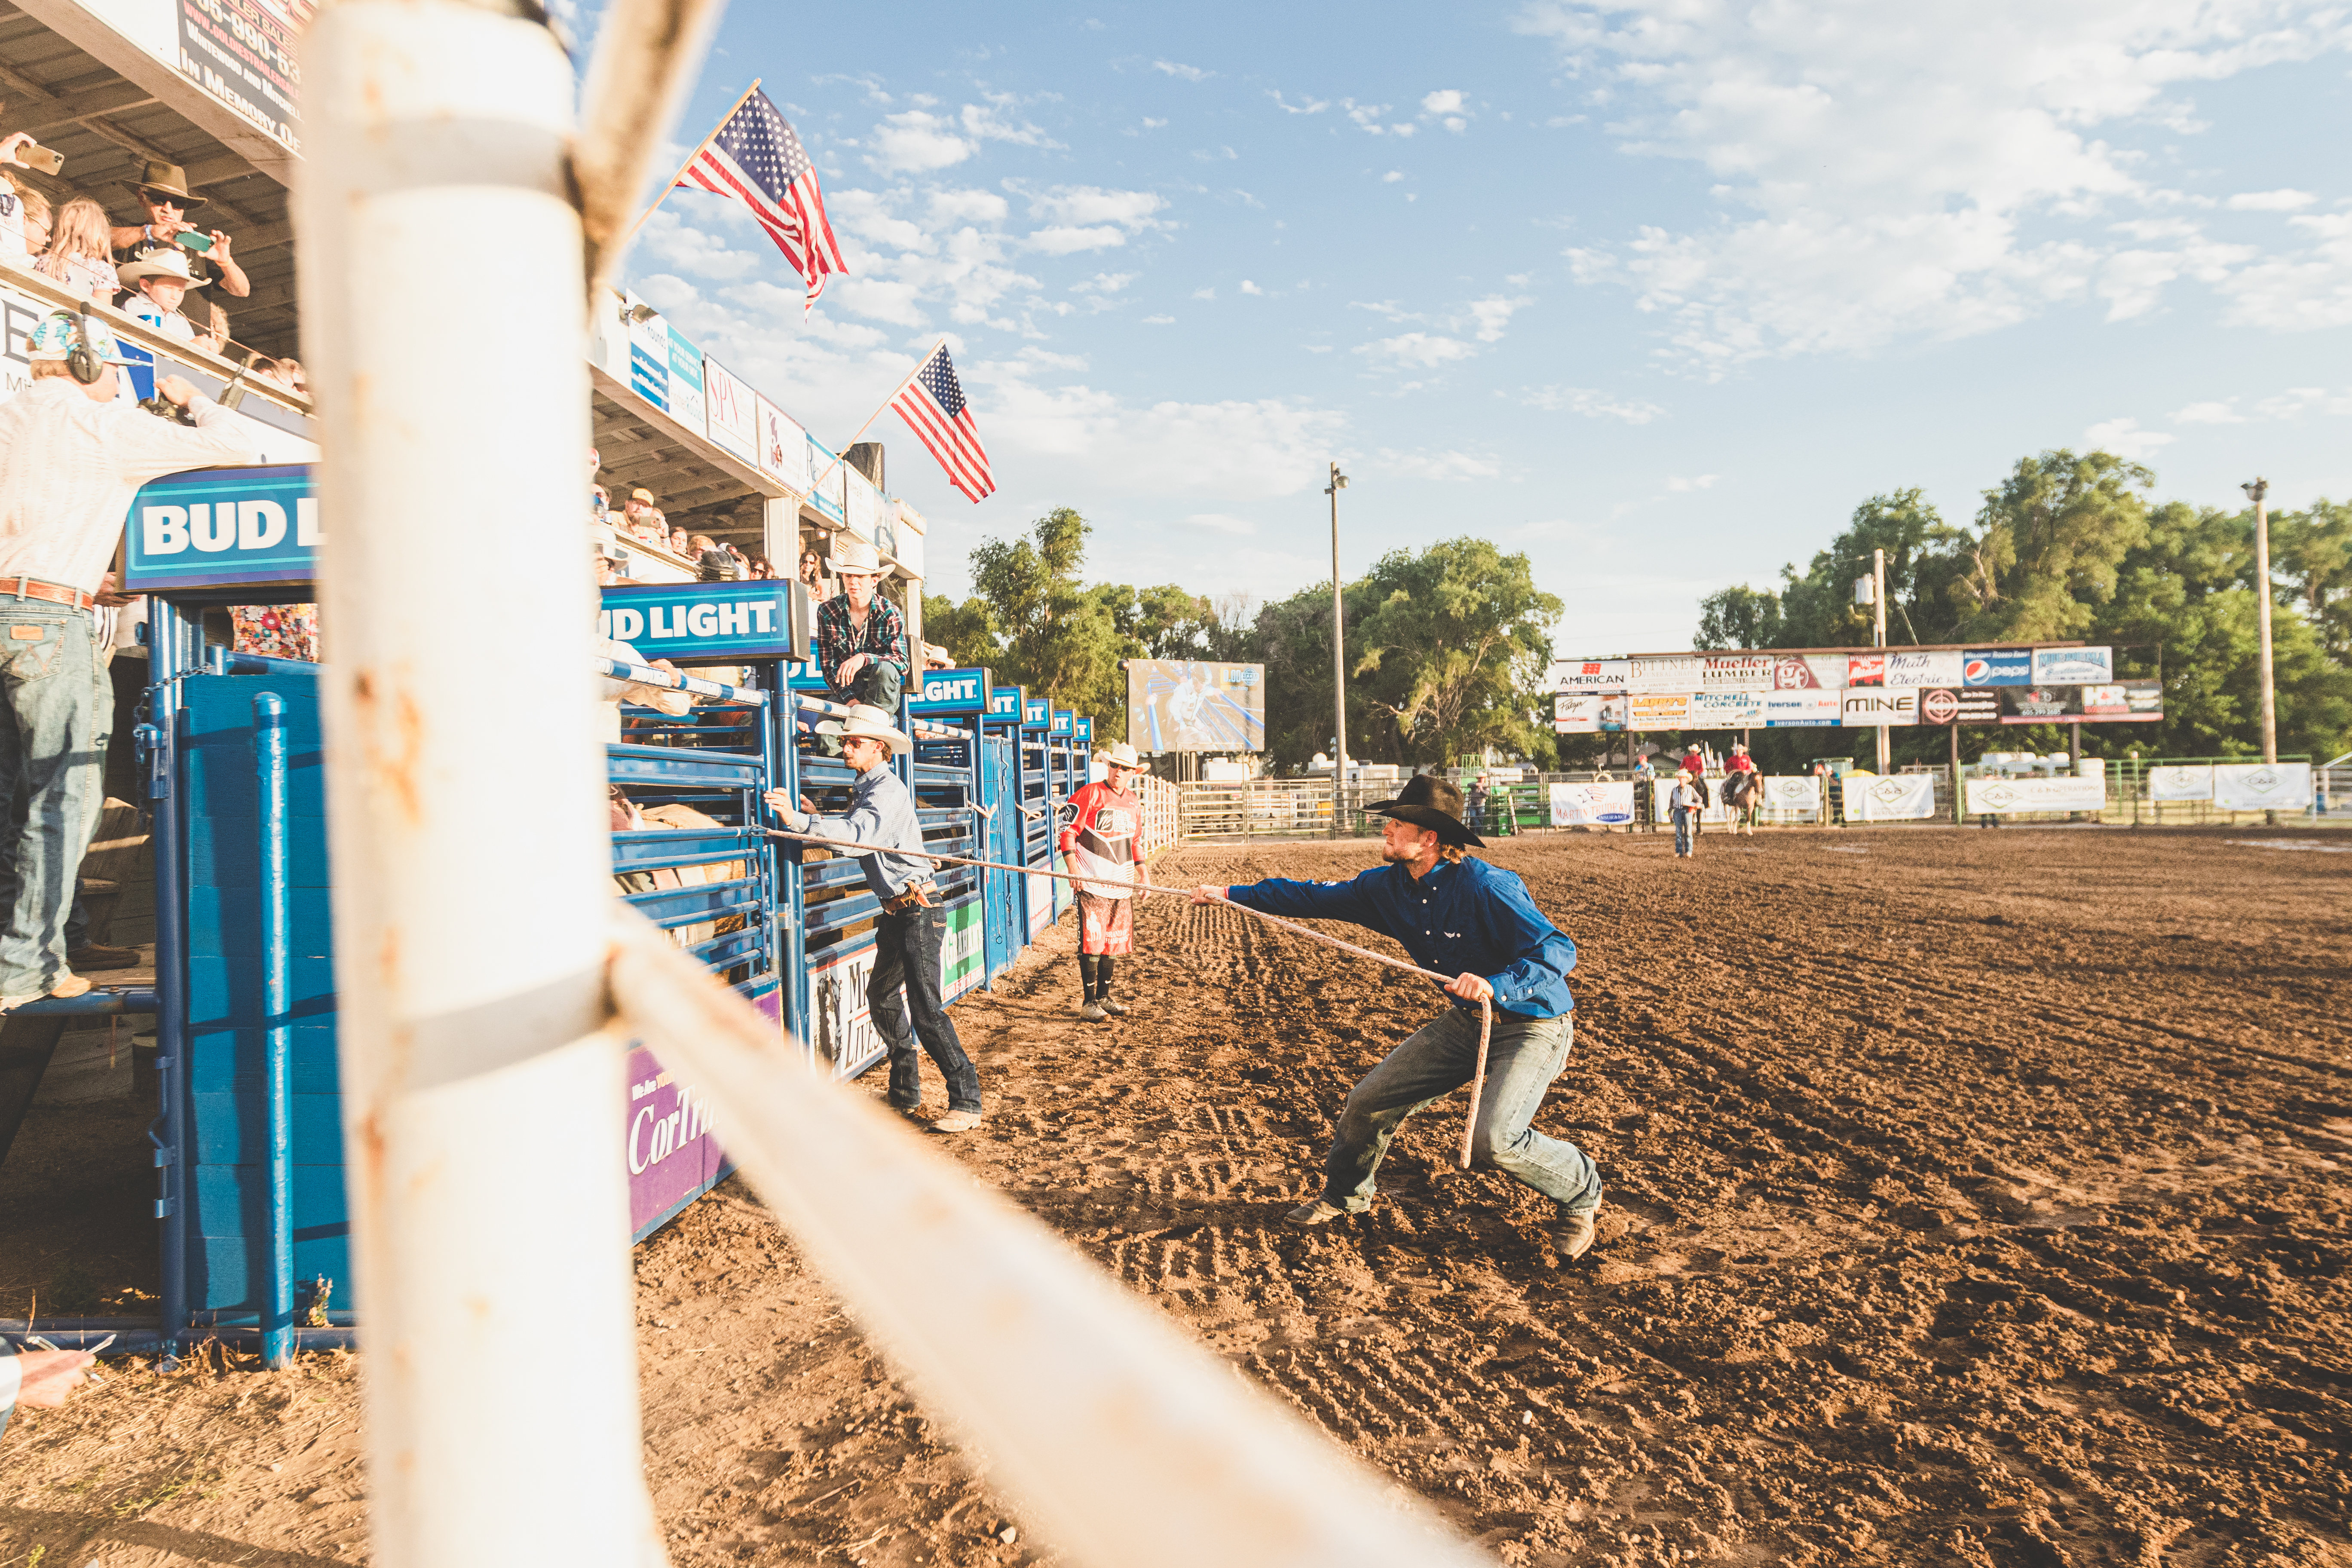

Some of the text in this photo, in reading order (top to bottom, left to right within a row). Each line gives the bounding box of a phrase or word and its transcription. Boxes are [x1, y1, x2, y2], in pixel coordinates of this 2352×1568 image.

[262, 17, 299, 56] SALES
[186, 18, 242, 76] WHITEWOOD
[243, 68, 261, 90] AND
[181, 46, 200, 81] IN
[204, 65, 276, 134] MEMORY
[710, 365, 739, 430] SPN
[142, 499, 288, 555] BUD
[649, 600, 776, 639] LIGHT
[1630, 658, 1698, 678] BITTNER
[1705, 657, 1771, 669] Mueller
[1890, 654, 1931, 669] Muth
[1224, 669, 1241, 683] 0.00
[1703, 669, 1772, 678] LUMBER
[1850, 665, 1883, 679] Mitchell
[1992, 665, 2029, 677] pepsi
[1560, 675, 1625, 685] AMERICAN
[1890, 673, 1944, 686] Electric
[1558, 698, 1588, 714] Patzer
[1632, 696, 1687, 707] LARRY'S
[1703, 700, 1762, 708] CONCRETE
[1846, 695, 1914, 712] MINE
[1874, 787, 1902, 796] C&B
[1984, 791, 2014, 801] C&B
[1556, 802, 1630, 820] MARTIN-TRUDEAU
[946, 919, 983, 970] GRAHAM'S
[1105, 936, 1128, 945] HAMPIONS
[955, 974, 971, 993] SOUTH
[970, 966, 984, 984] BURR
[632, 1084, 644, 1101] We
[644, 1080, 657, 1096] Are
